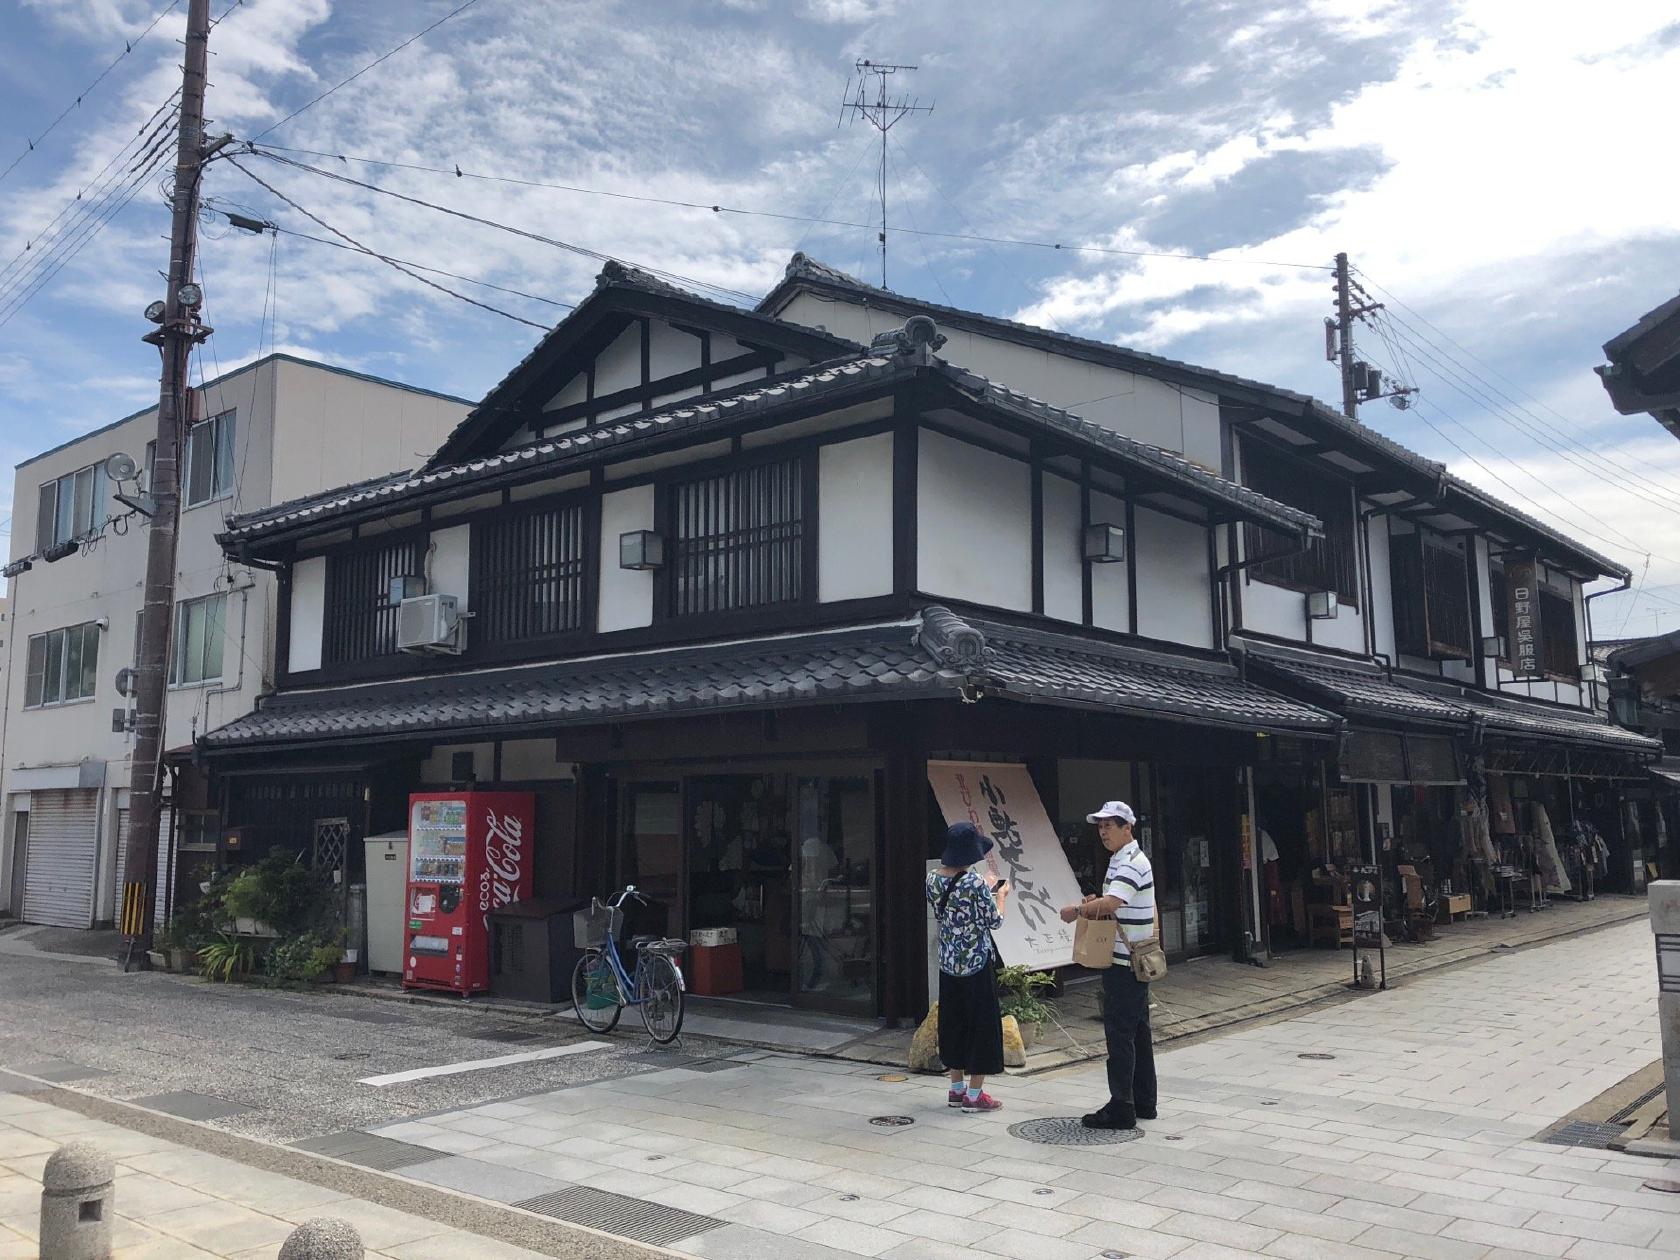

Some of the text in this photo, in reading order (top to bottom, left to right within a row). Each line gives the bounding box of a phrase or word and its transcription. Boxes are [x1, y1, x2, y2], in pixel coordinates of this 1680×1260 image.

[1515, 588, 1535, 670] 日野屋呉服店
